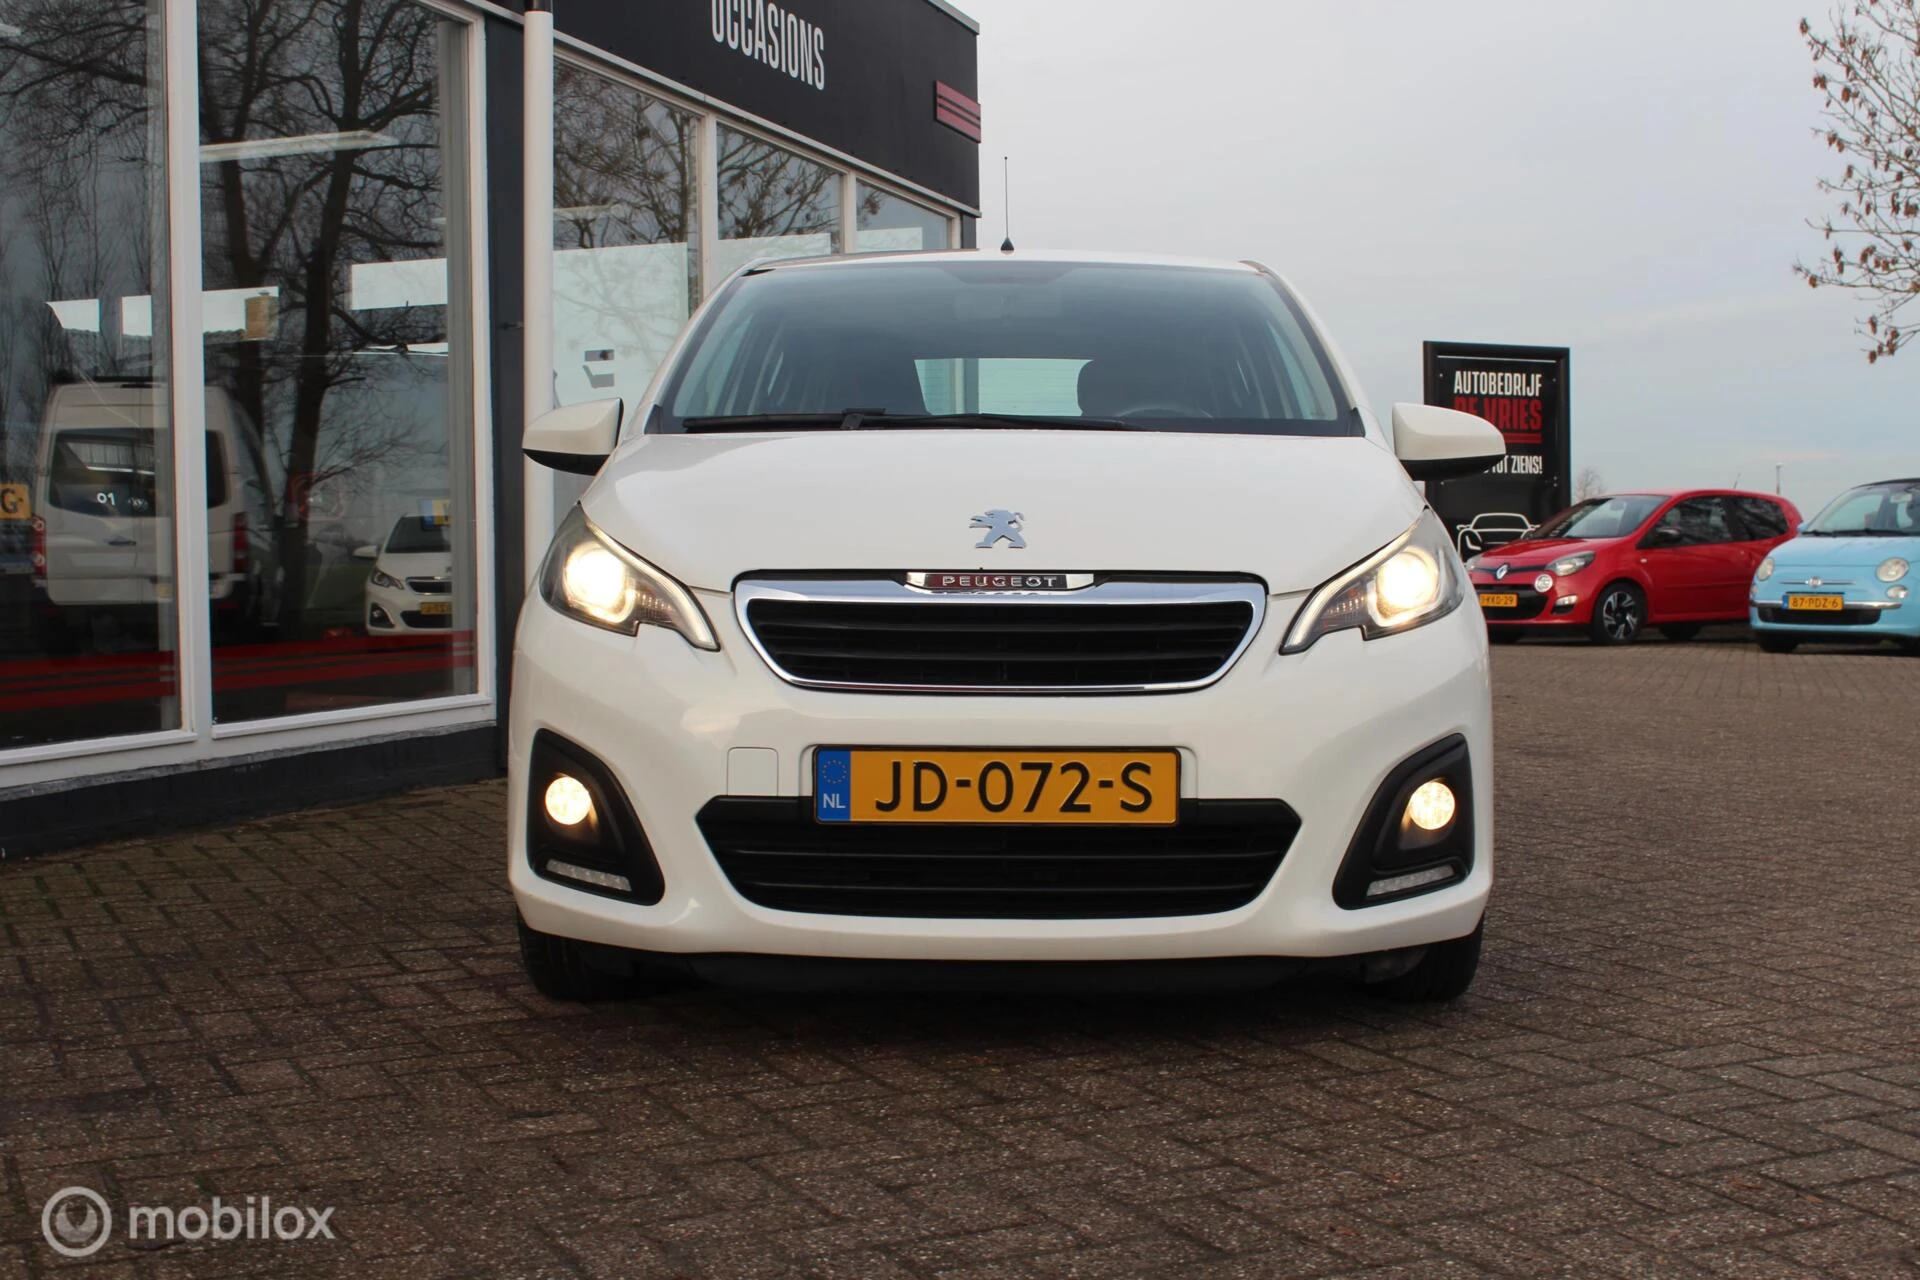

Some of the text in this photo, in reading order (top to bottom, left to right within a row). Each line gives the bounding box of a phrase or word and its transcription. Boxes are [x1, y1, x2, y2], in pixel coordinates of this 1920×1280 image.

[711, 0, 825, 90] OCCASIONS
[1453, 370, 1543, 397] AUTOBEDRIJF
[1511, 455, 1543, 475] ZIENS!
[942, 575, 1057, 587] PEUGEOT
[875, 760, 1153, 813] JD-072-S
[823, 793, 846, 809] NL
